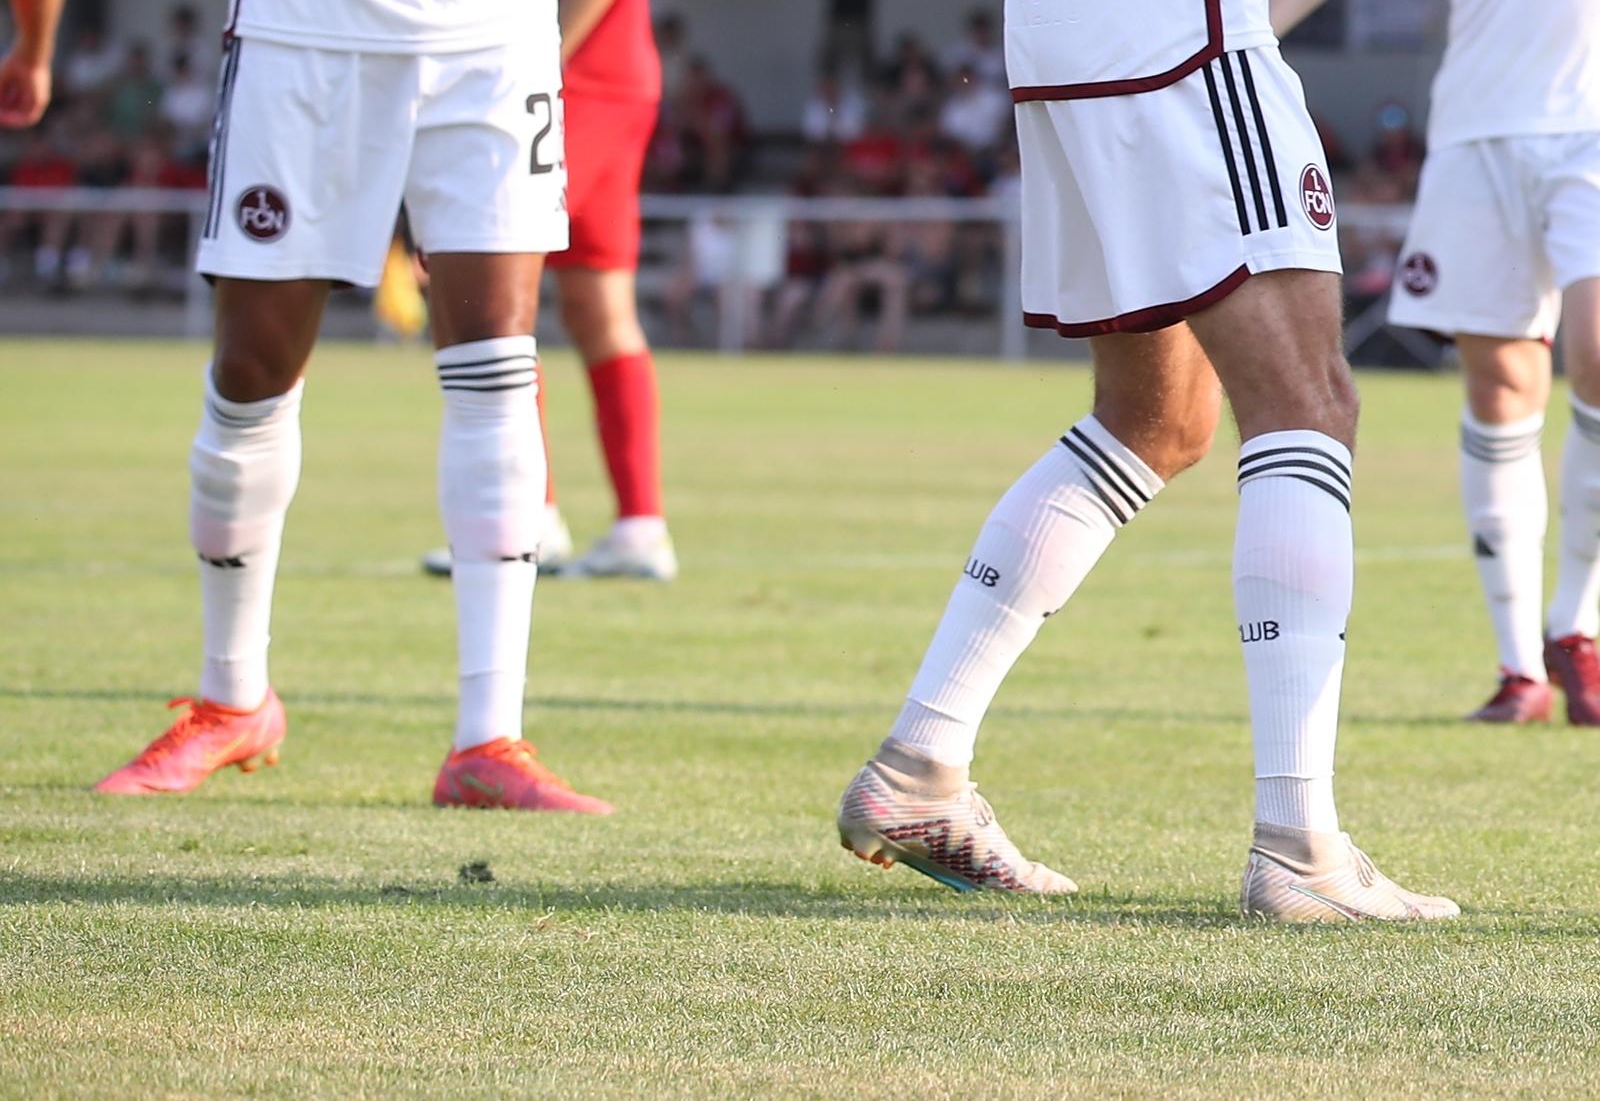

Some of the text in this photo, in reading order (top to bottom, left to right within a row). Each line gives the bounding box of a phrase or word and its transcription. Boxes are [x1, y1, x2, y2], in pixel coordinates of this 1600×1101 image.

[525, 89, 564, 175] 2
[1304, 190, 1333, 214] FCN
[963, 554, 1000, 587] LUB
[1239, 620, 1280, 643] LUB
